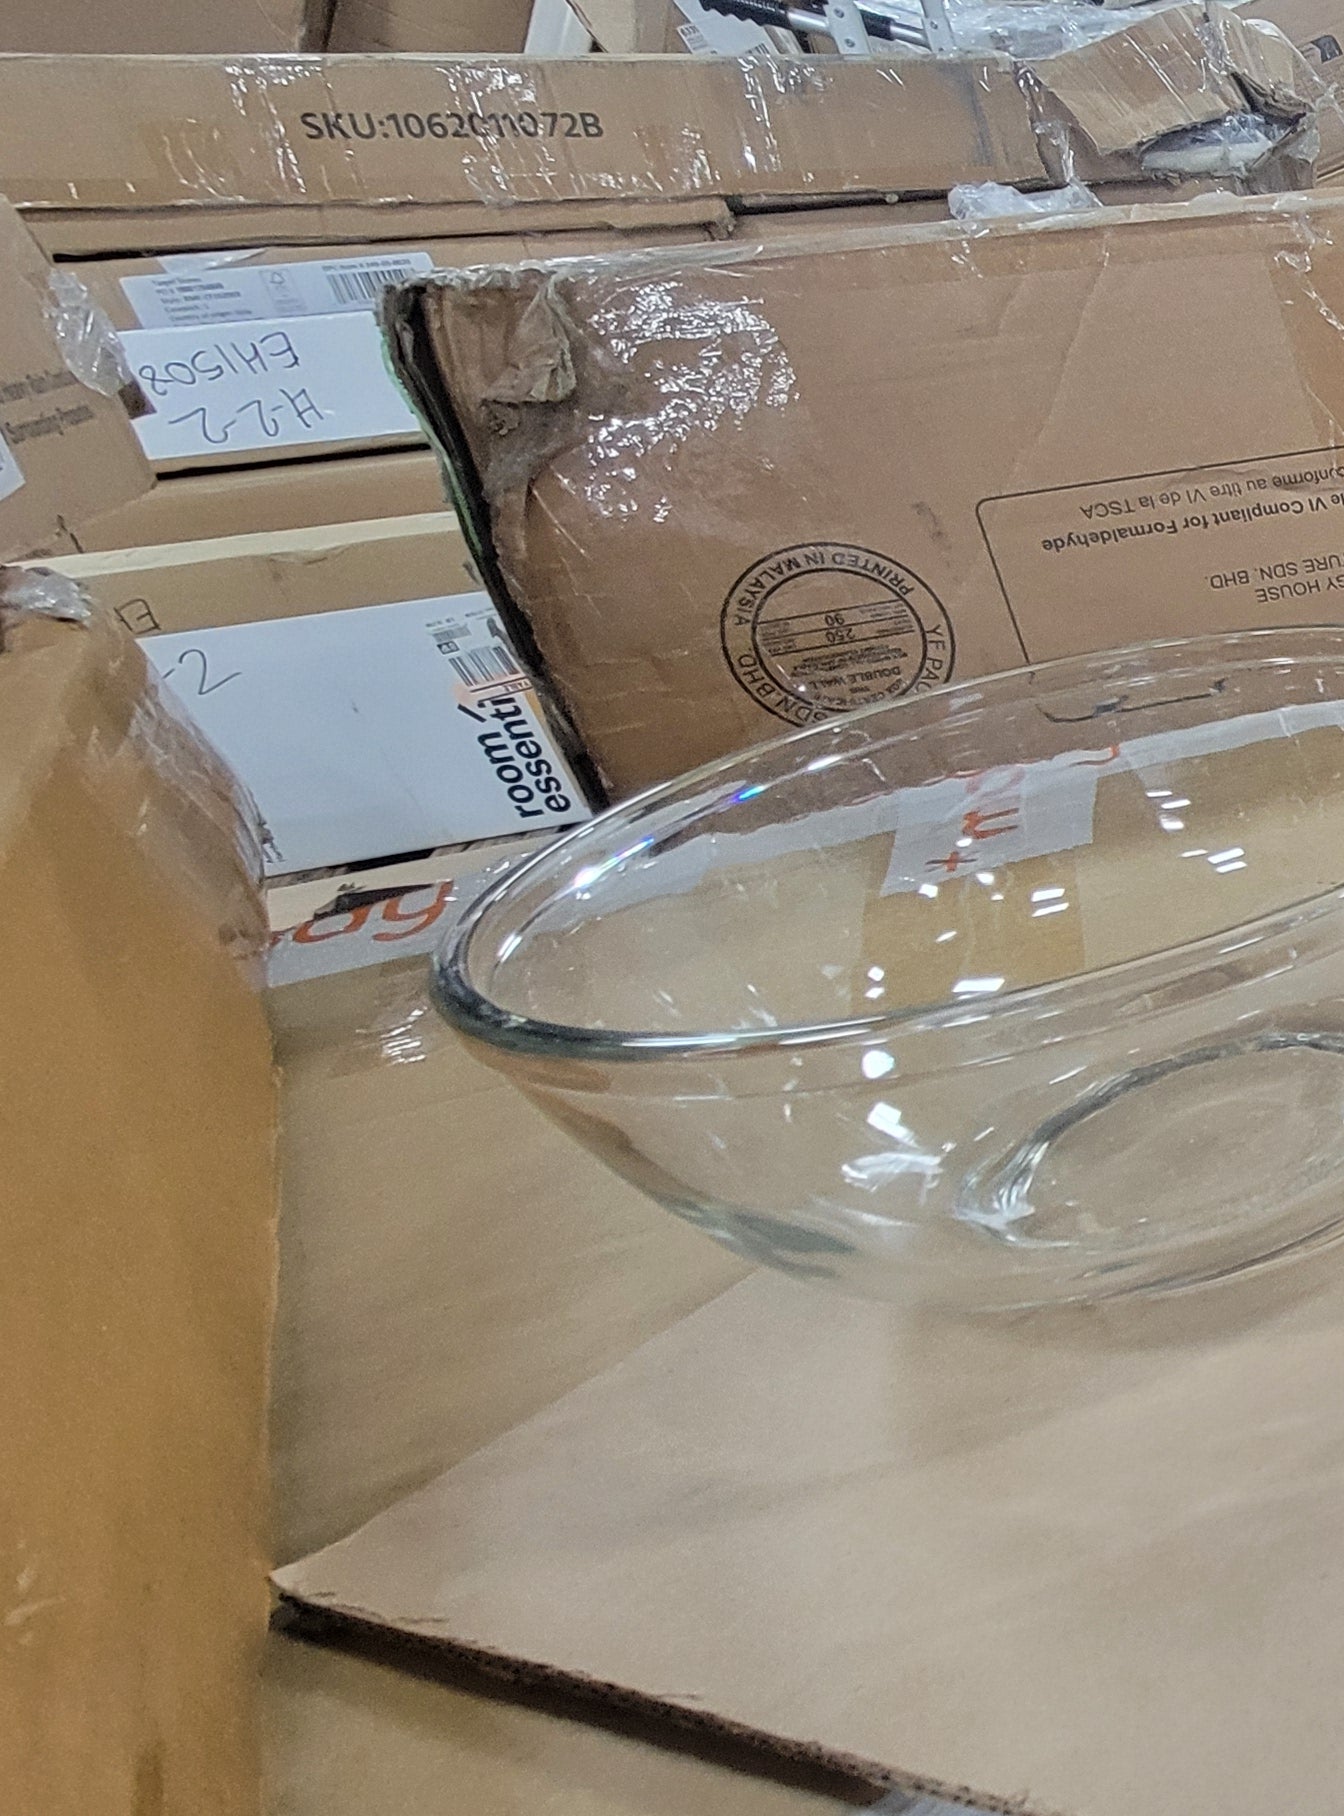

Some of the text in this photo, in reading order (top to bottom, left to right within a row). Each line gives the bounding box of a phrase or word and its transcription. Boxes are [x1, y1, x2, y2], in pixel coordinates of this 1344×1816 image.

[1210, 483, 1243, 498] titre
[1246, 478, 1268, 492] au
[1139, 495, 1156, 510] la
[1160, 490, 1182, 506] de
[1188, 488, 1207, 504] VI
[1309, 496, 1329, 512] VI
[1079, 498, 1136, 520] TSCA
[1213, 499, 1305, 526] Compliant
[1182, 514, 1210, 530] for
[1041, 519, 1178, 554] Formaldehyde
[1204, 569, 1251, 590] BHD.
[1257, 563, 1299, 582] SDN.
[733, 551, 915, 627] PRINTED IN MALAYSIA
[1254, 580, 1321, 603] HOUSE
[477, 731, 545, 818] room
